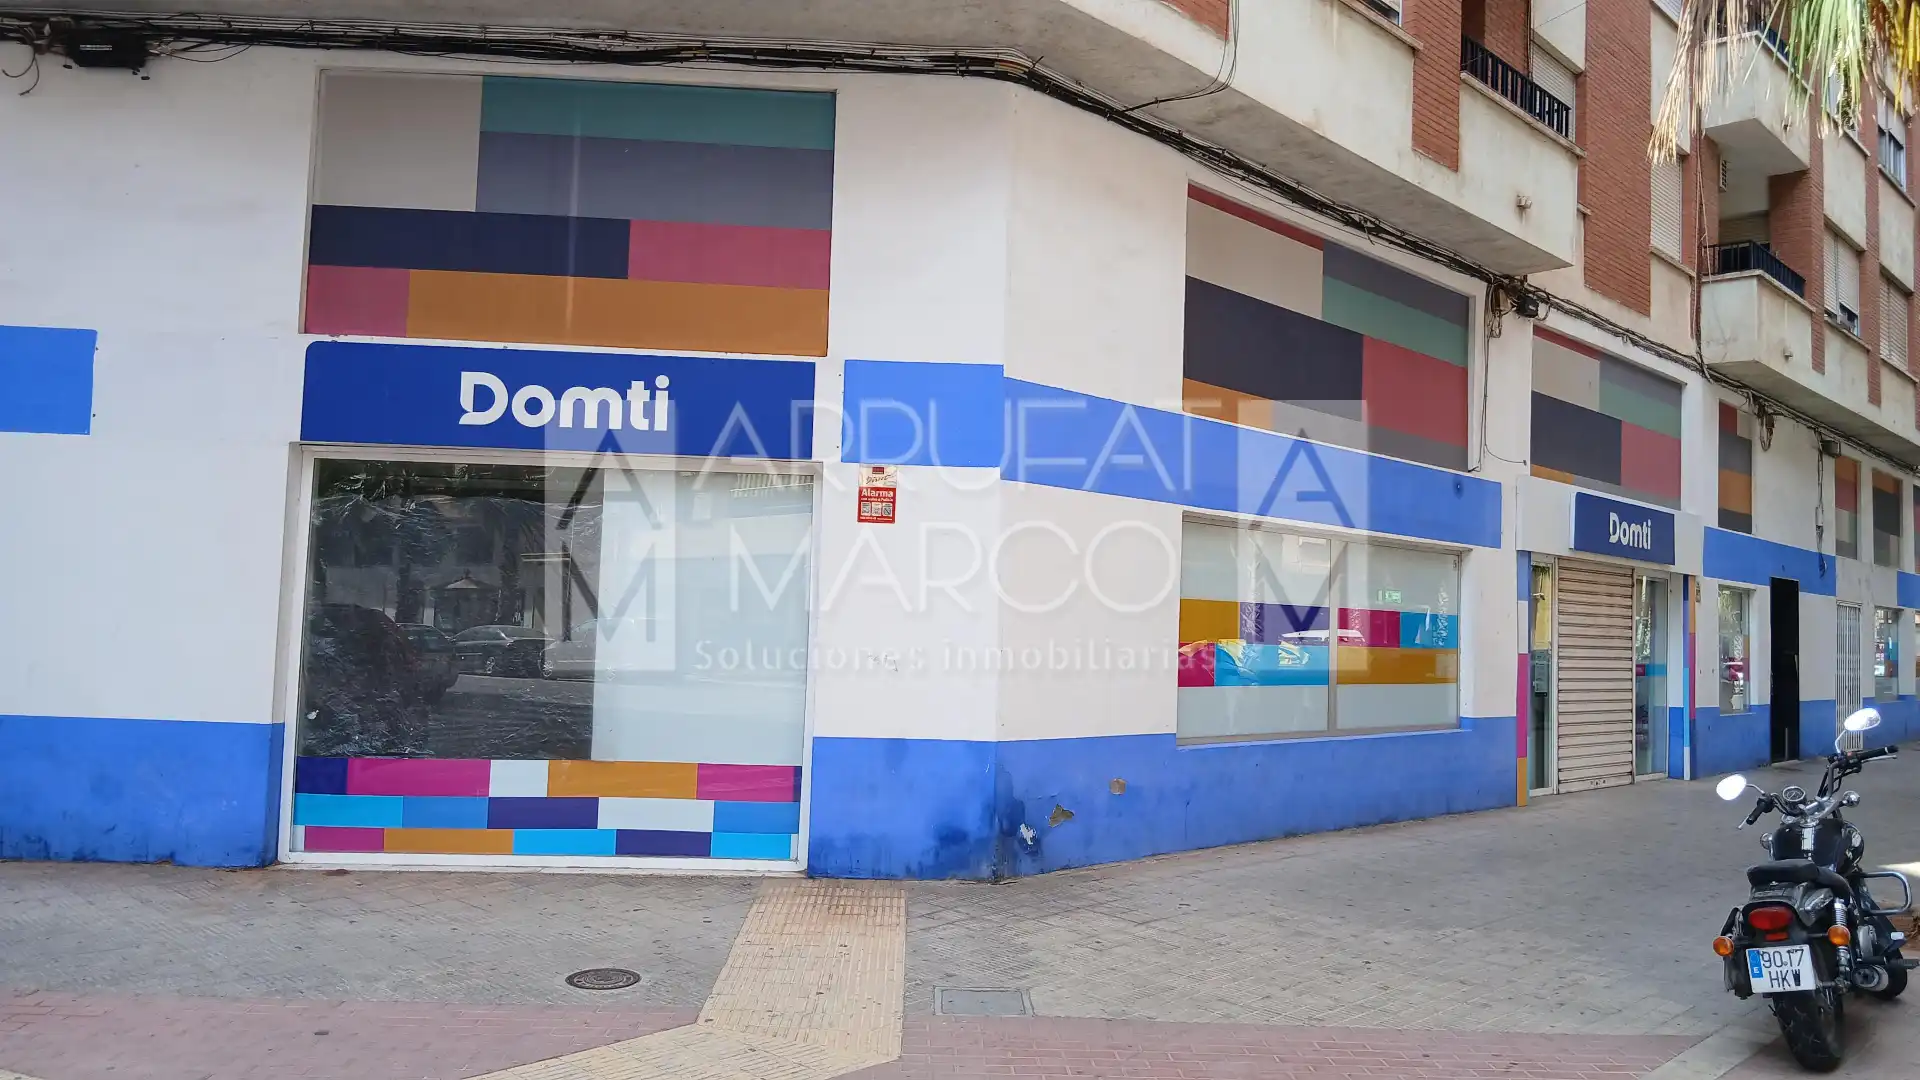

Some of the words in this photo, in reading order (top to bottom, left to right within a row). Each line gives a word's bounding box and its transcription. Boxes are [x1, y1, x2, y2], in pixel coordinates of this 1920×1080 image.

[458, 371, 669, 431] Domti
[861, 487, 894, 498] Alarma
[1609, 511, 1651, 550] Domti
[1760, 948, 1804, 968] 9017
